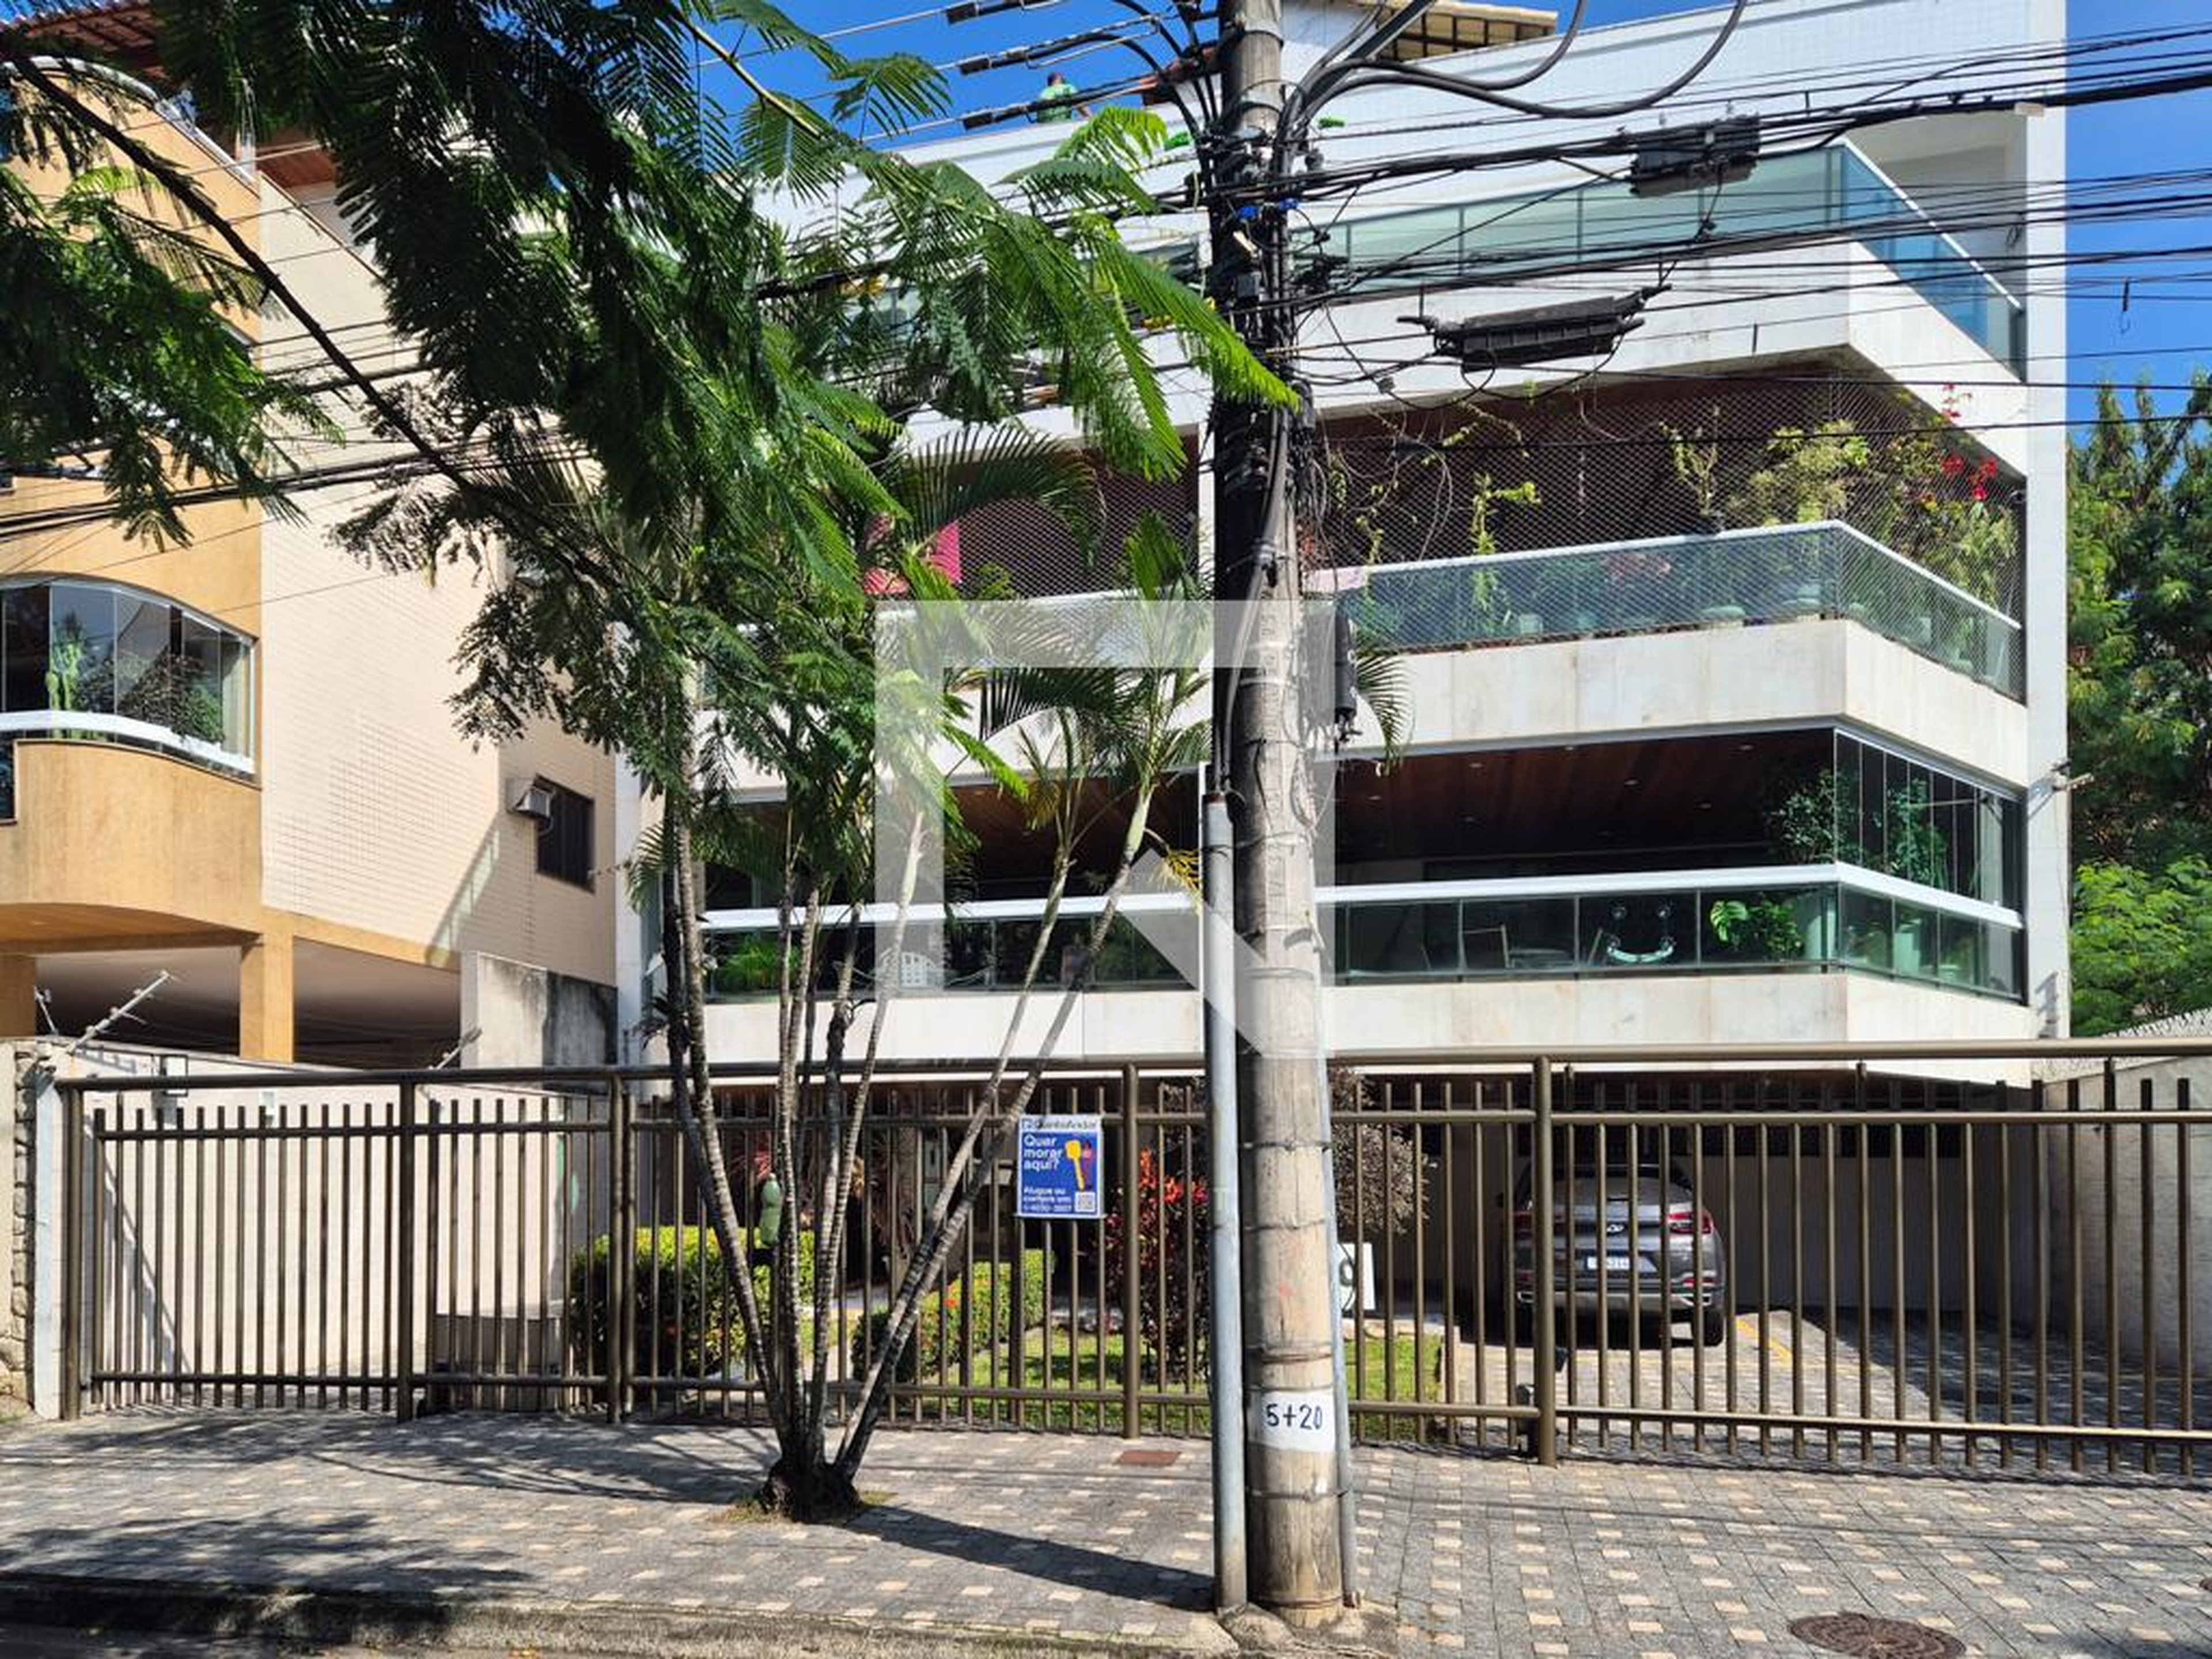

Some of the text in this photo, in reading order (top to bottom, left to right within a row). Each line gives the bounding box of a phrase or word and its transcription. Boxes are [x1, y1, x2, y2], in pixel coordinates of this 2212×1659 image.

[1024, 1134, 1057, 1147] Quer
[1024, 1149, 1062, 1158] morar
[1024, 1159, 1059, 1172] aqui?
[1265, 1403, 1323, 1430] 5+20
